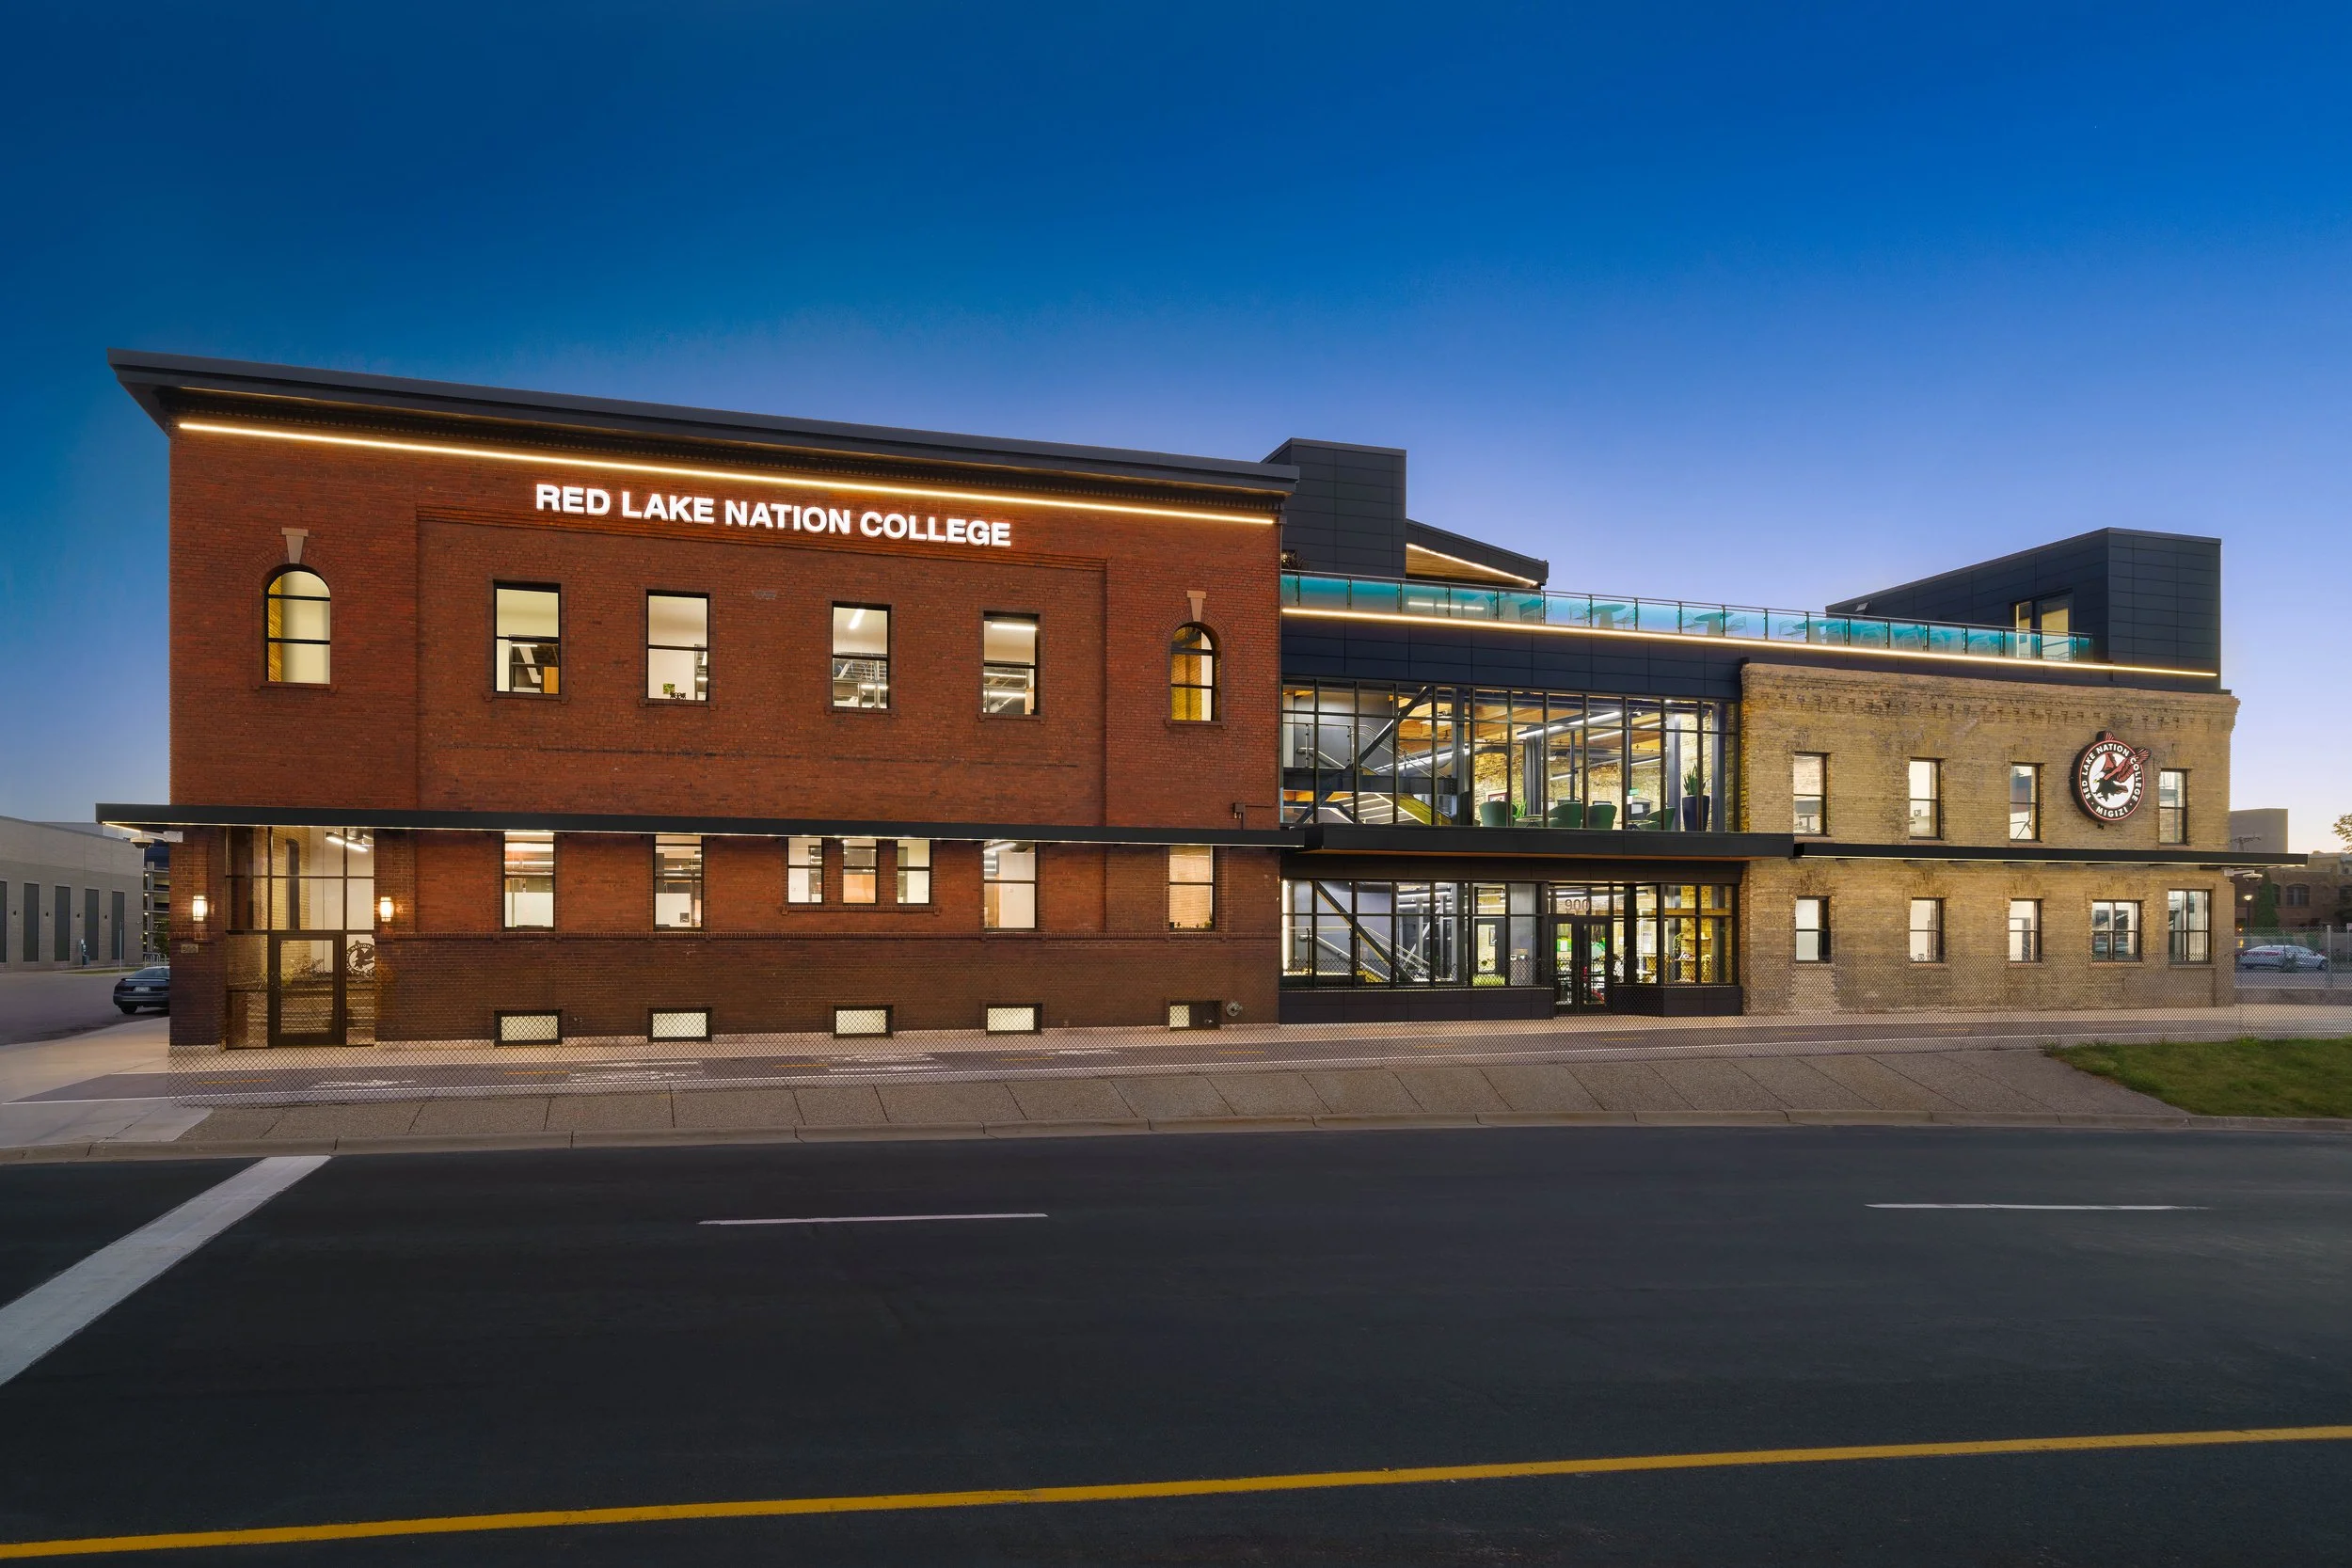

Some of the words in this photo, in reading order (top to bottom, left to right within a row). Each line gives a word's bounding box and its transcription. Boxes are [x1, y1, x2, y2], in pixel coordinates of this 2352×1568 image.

[536, 484, 611, 516] RED
[621, 492, 715, 524] LAKE
[724, 500, 851, 534] NATION
[860, 512, 1011, 546] COLLEGE
[2096, 743, 2129, 757] NATION
[2082, 752, 2095, 776] LAKE
[2130, 757, 2141, 801] COLLEGE
[2082, 780, 2091, 800] RED
[2096, 806, 2128, 817] MIGIZI
[1565, 899, 1589, 911] 900
